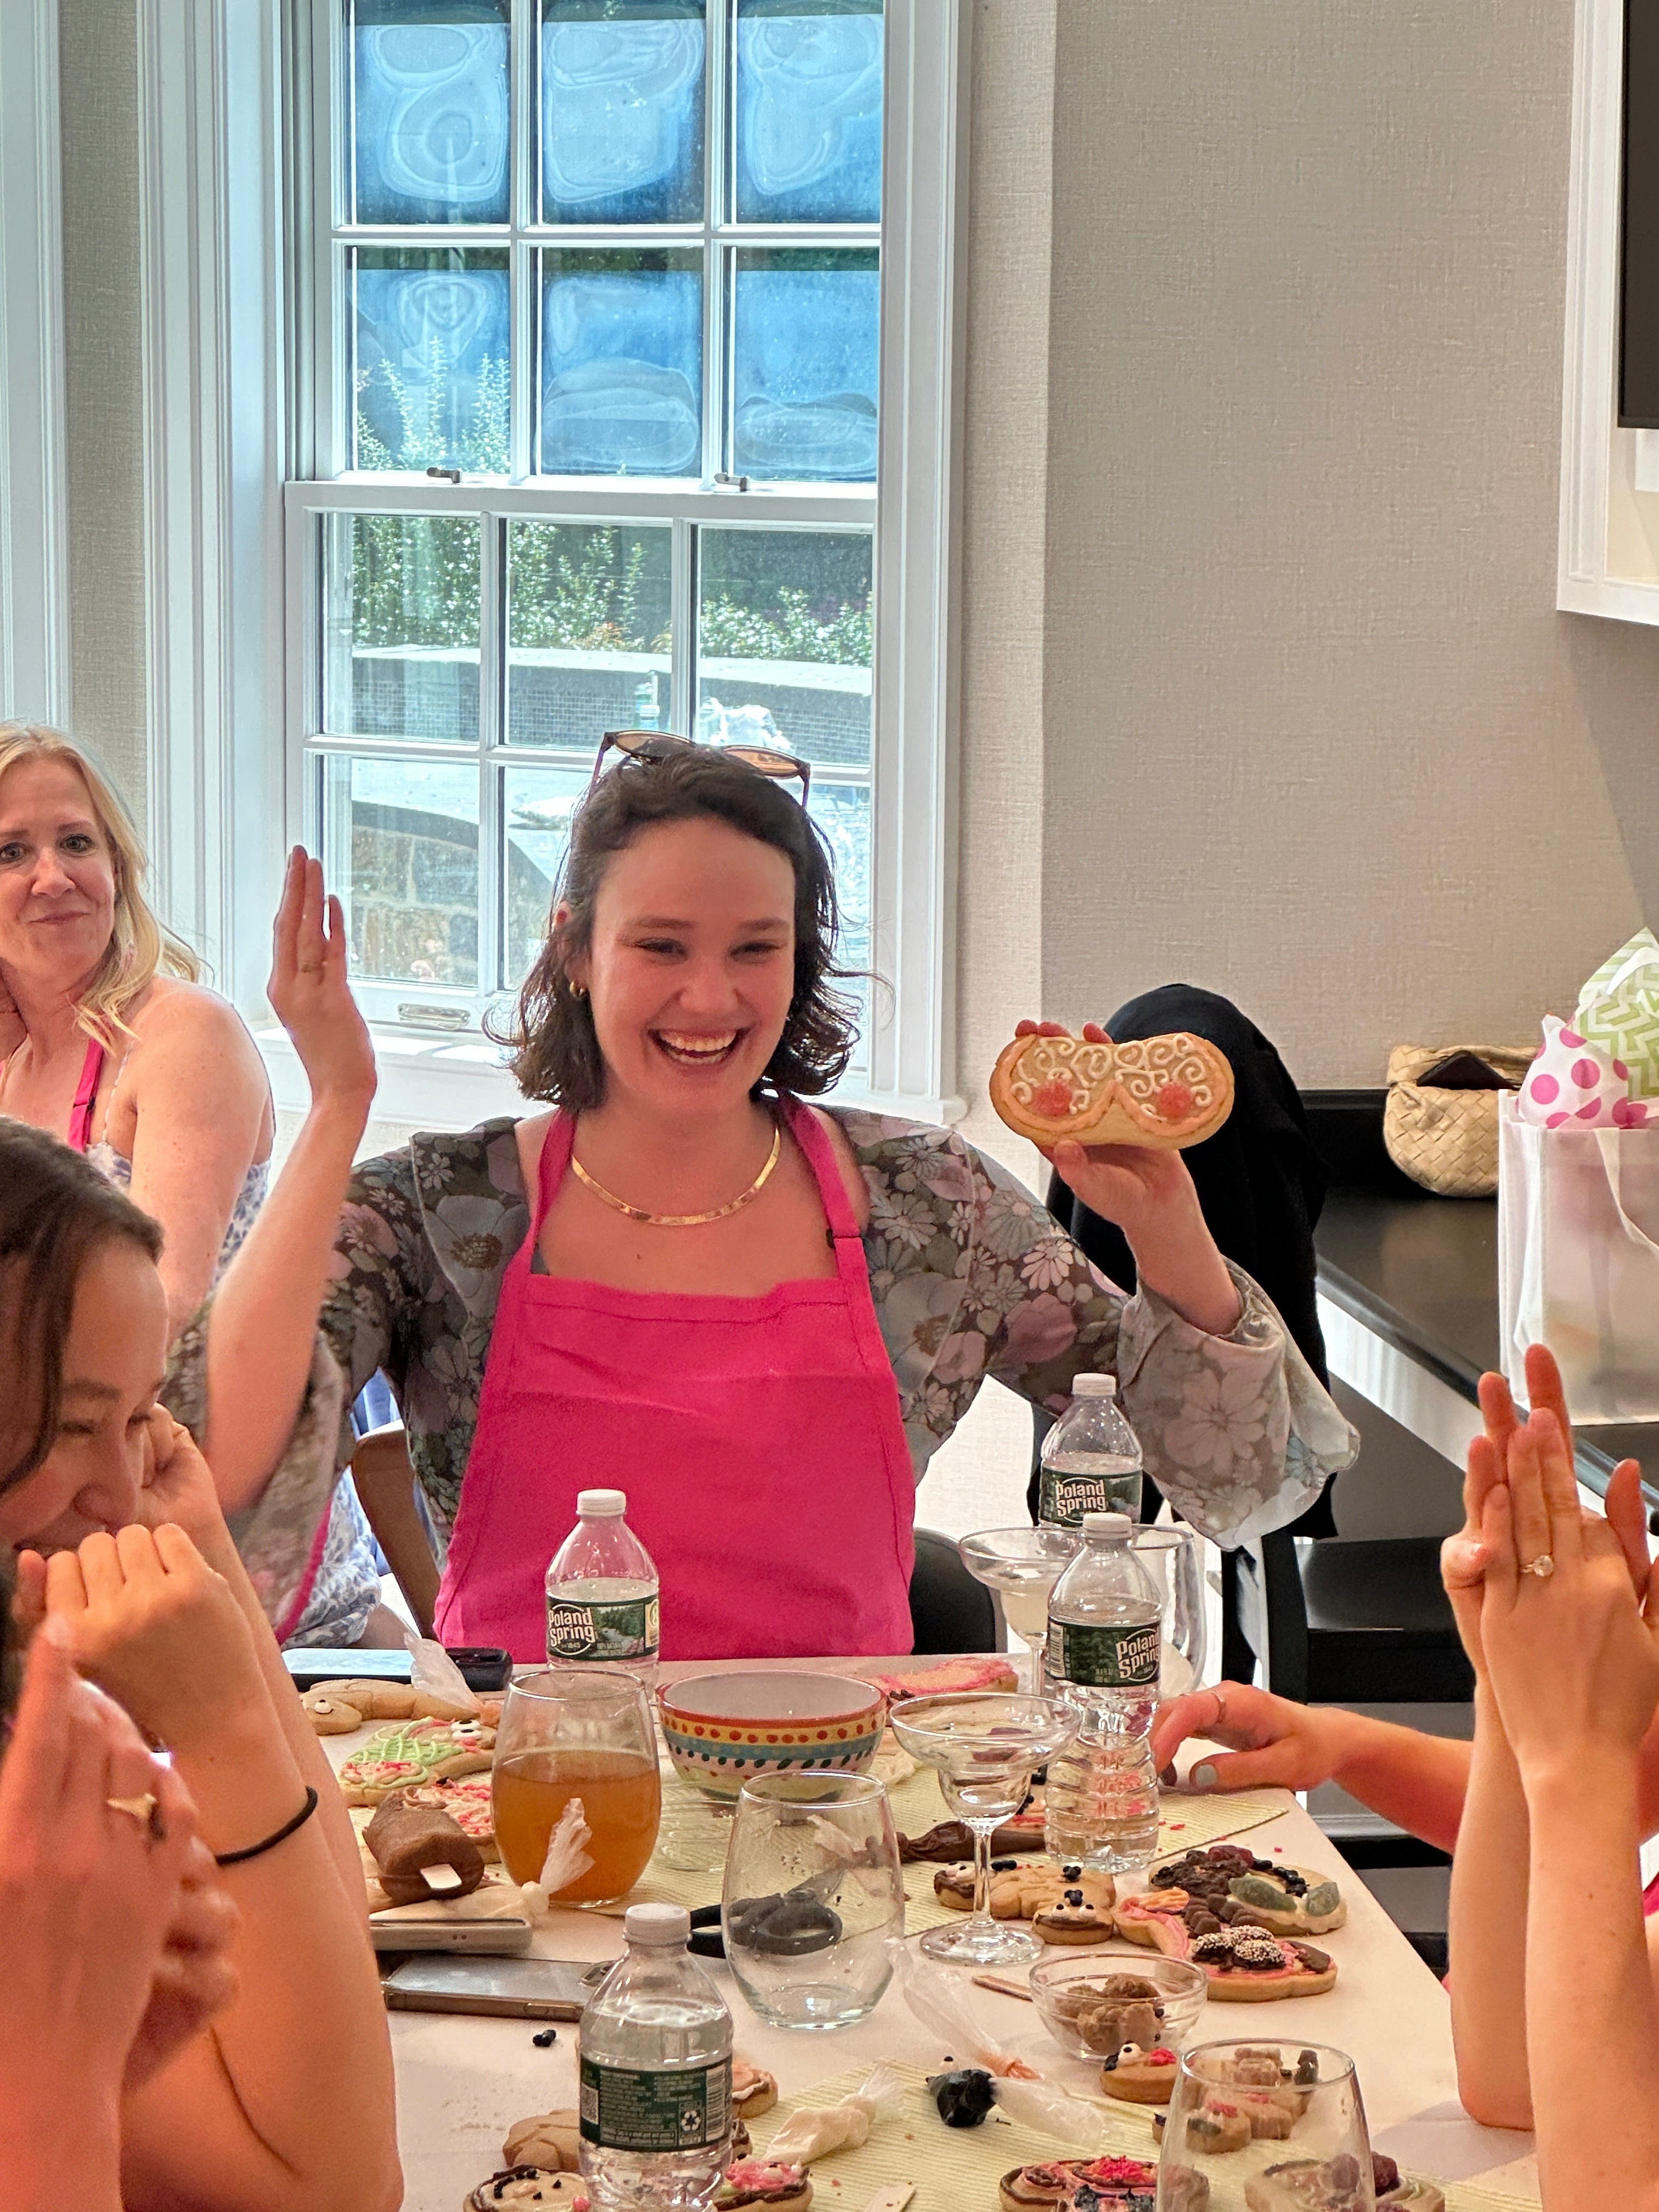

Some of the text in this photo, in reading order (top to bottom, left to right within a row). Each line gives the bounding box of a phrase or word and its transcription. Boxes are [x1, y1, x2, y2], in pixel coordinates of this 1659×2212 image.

[1056, 1479, 1105, 1500] Poland
[1056, 1496, 1107, 1516] Spring
[549, 1607, 594, 1628] Poland
[549, 1624, 596, 1647] Spring
[1115, 1626, 1160, 1661] Poland
[1118, 1646, 1160, 1679] Spring
